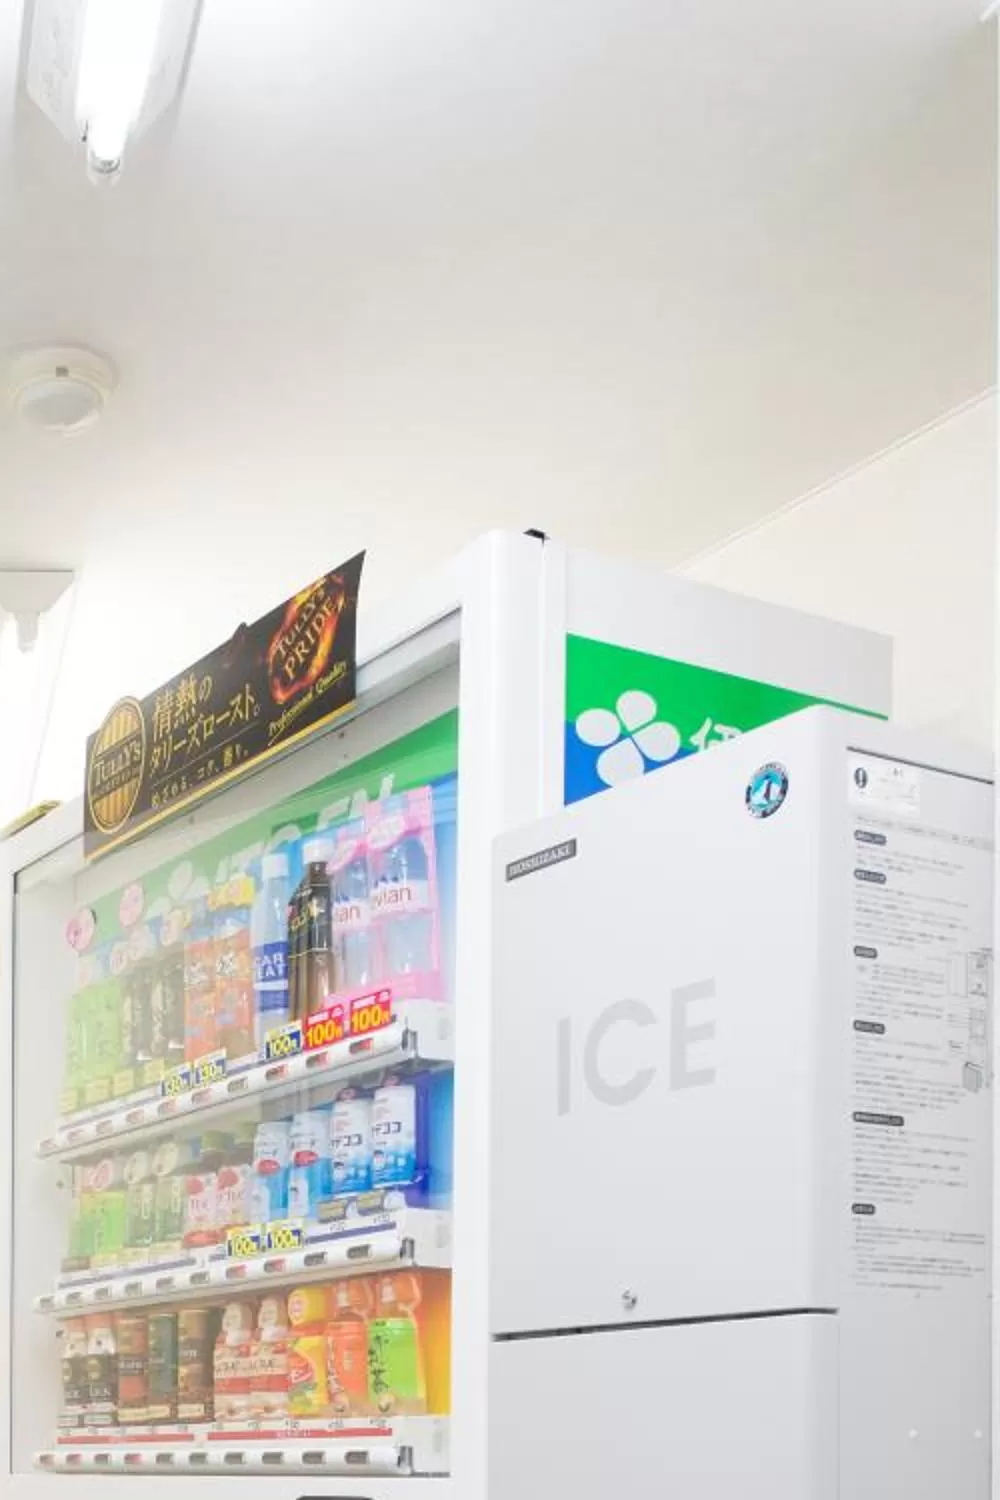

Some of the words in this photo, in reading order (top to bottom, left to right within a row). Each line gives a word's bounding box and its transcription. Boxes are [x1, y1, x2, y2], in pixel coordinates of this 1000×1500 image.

[284, 595, 336, 680] PRIDE
[152, 674, 214, 741] 情熱の
[557, 975, 717, 1117] ICE
